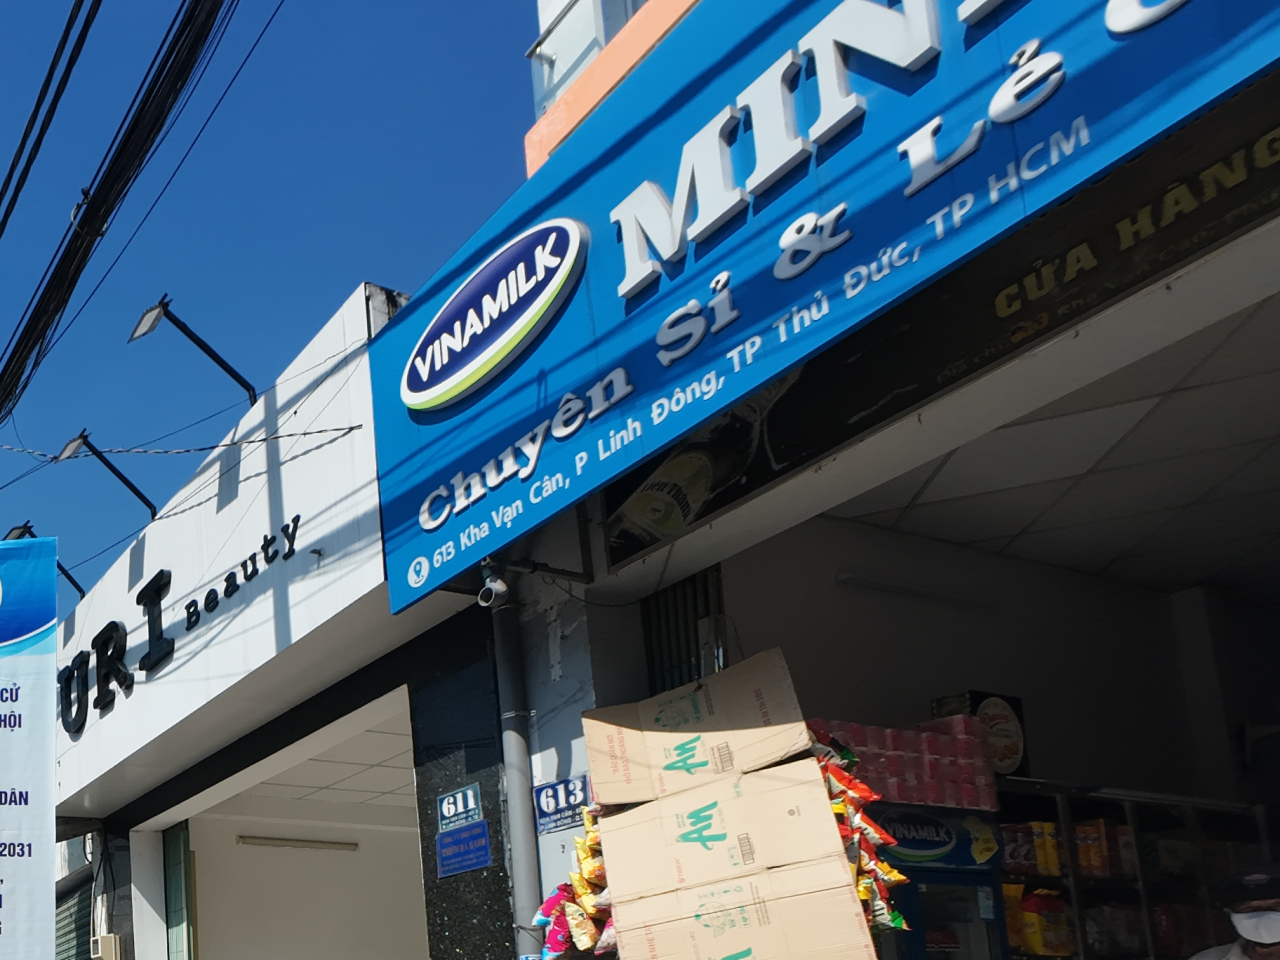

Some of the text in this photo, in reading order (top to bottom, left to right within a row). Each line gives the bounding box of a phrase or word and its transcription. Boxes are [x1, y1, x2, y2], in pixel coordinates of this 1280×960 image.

[610, 0, 1026, 298] MIN
[419, 38, 1066, 530] Chuyên Sỉ & Lẻ
[994, 242, 1097, 318] CỬA
[413, 232, 561, 382] VINAMILK
[432, 115, 1090, 568] 613 Kha Vạn Cân, P Linh Đông, TP Thủ Đức, TP HCM
[185, 515, 301, 631] Beauty
[0, 683, 20, 703] CỬ
[663, 735, 709, 775] An
[0, 788, 29, 806] DÂN
[442, 789, 477, 817] 611
[540, 779, 584, 813] 613
[675, 801, 728, 850] An
[885, 822, 950, 842] VINAMILK
[0, 842, 32, 858] 2031
